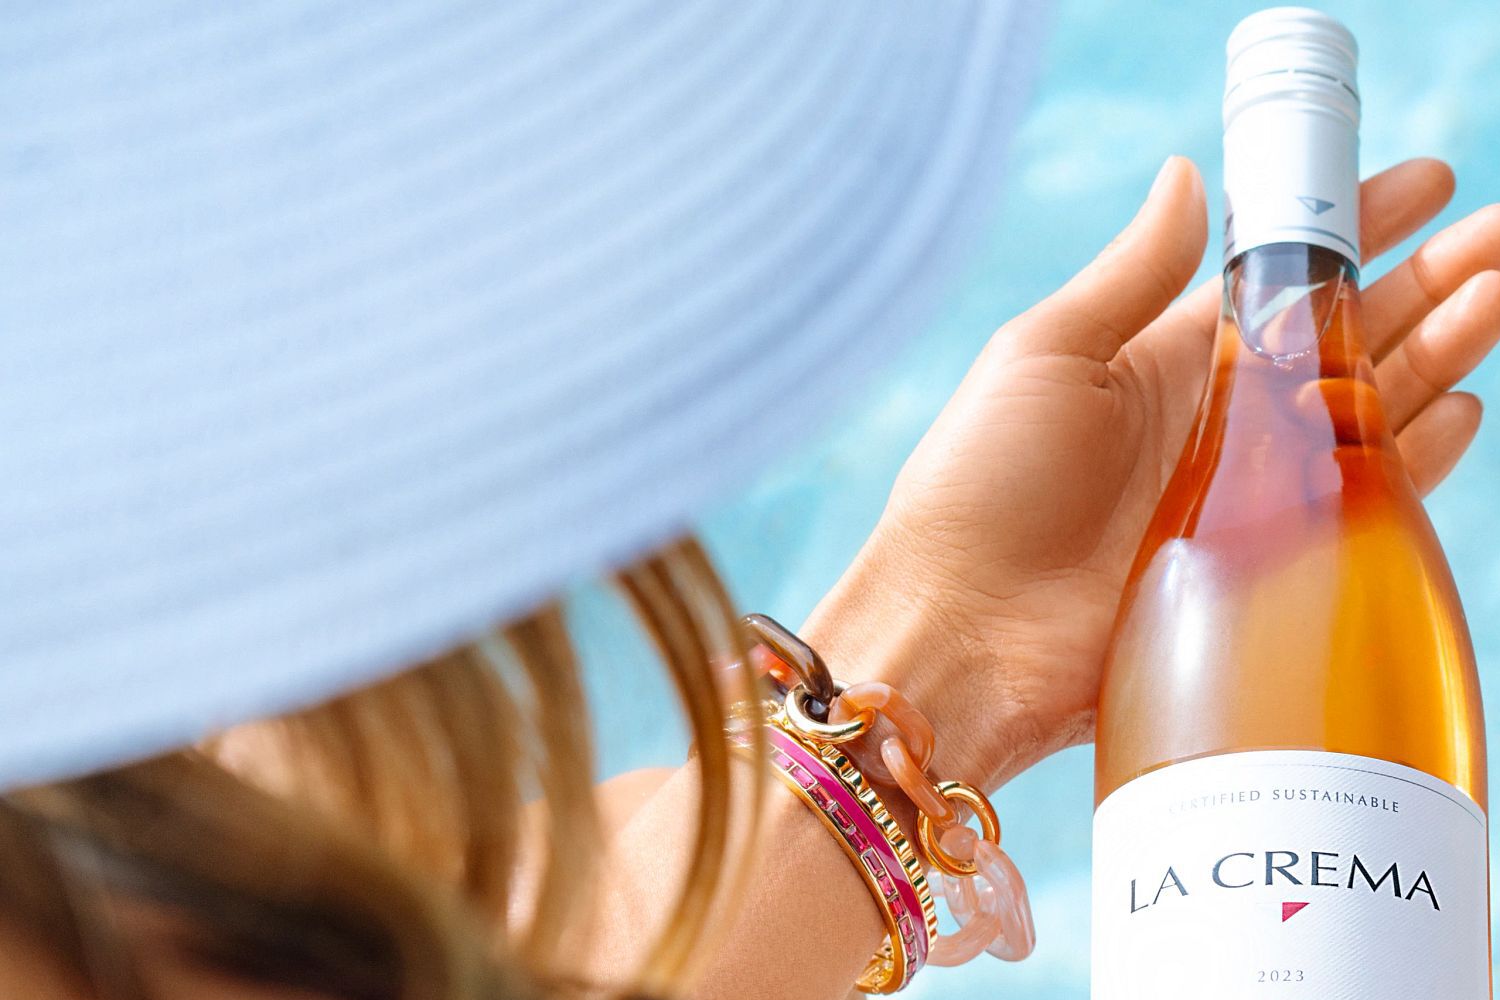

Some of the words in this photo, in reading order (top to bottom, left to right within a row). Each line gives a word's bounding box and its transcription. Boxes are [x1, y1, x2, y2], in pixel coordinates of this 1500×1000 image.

[1272, 789, 1399, 813] SUSTAINABLE
[1130, 866, 1189, 914] LA
[1212, 850, 1441, 912] CREMA
[1258, 969, 1304, 983] 2023
